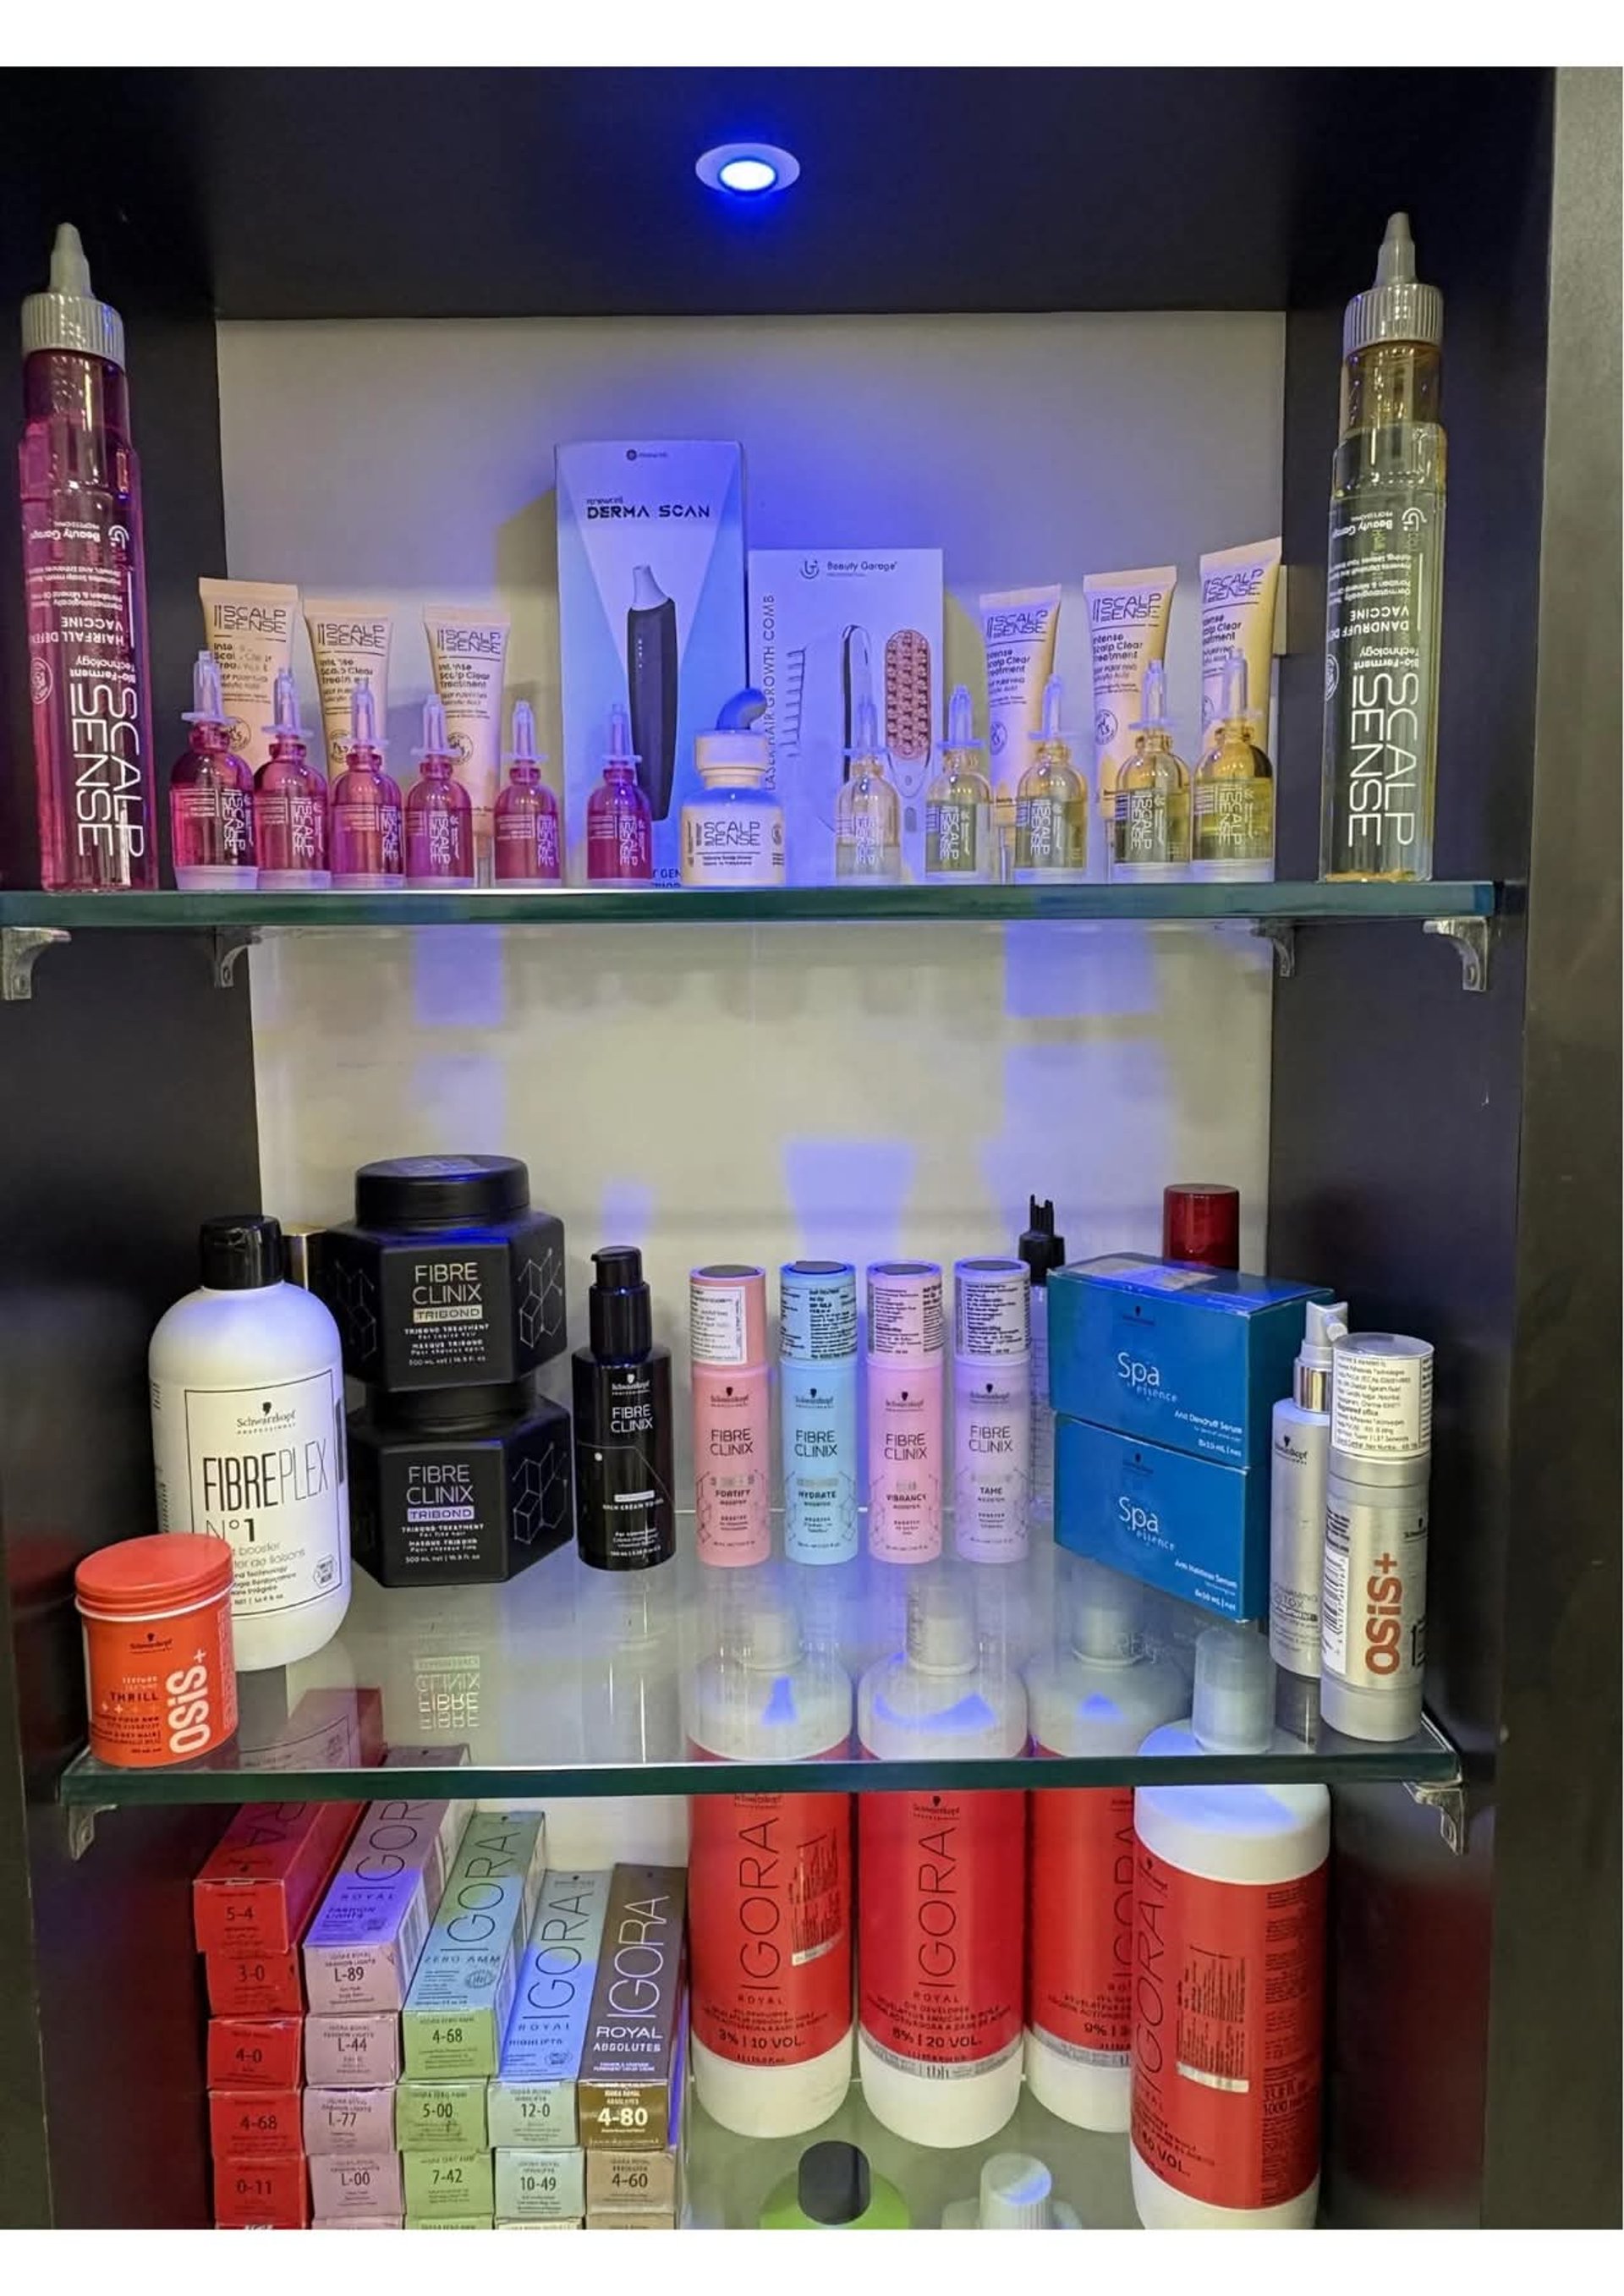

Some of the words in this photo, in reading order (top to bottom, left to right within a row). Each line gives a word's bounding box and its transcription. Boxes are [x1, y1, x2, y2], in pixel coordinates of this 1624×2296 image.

[588, 506, 650, 519] DERMA
[659, 505, 710, 518] SCAN
[1358, 519, 1393, 531] Beauty
[63, 527, 101, 542] Beauty
[827, 561, 858, 572] Beauty
[861, 561, 897, 572] Garage
[1102, 592, 1162, 609] SCALP
[223, 605, 286, 621] SCALP
[763, 595, 775, 641] COMB
[994, 609, 1049, 624] SCALP
[1100, 605, 1160, 622] SENSE
[1350, 605, 1409, 622] VACCINE
[61, 616, 123, 632] VACCINE
[223, 618, 287, 634] SENSE
[326, 623, 385, 637] SCALP
[1342, 621, 1409, 637] DANDRUFF
[63, 631, 124, 646] HAIRFALL
[445, 629, 501, 644] SCALP
[1359, 646, 1419, 658] Technology
[75, 655, 135, 673] Technology
[1353, 657, 1419, 670] Bio-Ferment
[764, 646, 775, 709] GROWTH
[1348, 673, 1385, 848] SENSE
[1385, 673, 1419, 845] SCALP
[69, 683, 113, 856] SENSE
[107, 685, 145, 857] SCALP
[233, 794, 246, 851] SCALP
[704, 821, 760, 836] SCALP
[1142, 798, 1153, 849] SCALP
[438, 816, 451, 865] SCALP
[704, 832, 760, 846] SENSE
[414, 1262, 479, 1283] FIBRE
[412, 1283, 483, 1305] CLINIX
[415, 1308, 480, 1321] TRIBOND
[1117, 1352, 1160, 1387] Spa
[1136, 1386, 1177, 1403] essence
[236, 1409, 296, 1428] Schwarzkopf
[612, 1404, 651, 1419] FIBRE
[611, 1416, 653, 1433] CLINIX
[970, 1425, 1011, 1439] FIBRE
[711, 1428, 751, 1442] FIBRE
[795, 1430, 835, 1443] FIBRE
[886, 1433, 926, 1447] FIBRE
[710, 1442, 754, 1457] CLINIX
[794, 1444, 837, 1458] CLINIX
[968, 1439, 1013, 1453] CLINIX
[884, 1447, 927, 1461] CLINIX
[202, 1438, 329, 1512] FIBREPLEX
[408, 1464, 470, 1484] FIBRE
[406, 1485, 475, 1505] CLINIX
[716, 1489, 751, 1498] FORTIFY
[798, 1490, 837, 1499] HYDRATE
[886, 1493, 927, 1502] VIBRANCY
[979, 1486, 1003, 1495] TAME
[409, 1508, 472, 1520] TRIBOND
[1118, 1496, 1159, 1533] Spa
[239, 1541, 281, 1556] booster
[1136, 1531, 1176, 1551] essence
[110, 1691, 159, 1701] THRILL
[440, 1832, 521, 1952] IGORA
[738, 1816, 780, 1991] IGORA
[918, 1826, 957, 1987] IGORA
[225, 1907, 254, 1921] 5-4
[467, 1955, 501, 1964] AMM
[522, 1892, 593, 2019] IGORA
[606, 1895, 670, 2019] IGORA
[238, 1964, 266, 1982] 3-0
[334, 1965, 365, 1982] L-89
[738, 1993, 783, 2005] ROYAL
[914, 1991, 960, 2003] ROYAL
[1136, 1901, 1165, 2094] IGORA
[432, 2028, 463, 2044] 4-68
[595, 2026, 663, 2039] ROYAL
[718, 2028, 739, 2046] 3%
[751, 2037, 768, 2049] 10
[771, 2035, 805, 2049] VOL.
[338, 2038, 367, 2052] L-44
[593, 2042, 661, 2052] ABSOLUTES
[925, 2035, 945, 2048] 20
[948, 2034, 983, 2048] VOL.
[235, 2046, 262, 2063] 4-0
[423, 2103, 453, 2118] 5-00
[520, 2103, 550, 2117] 12-0
[596, 2107, 648, 2127] 4-80
[239, 2115, 277, 2130] 4-68
[328, 2112, 357, 2126] L-77
[341, 2172, 370, 2187] L-00
[432, 2168, 463, 2183] 7-42
[612, 2173, 648, 2188] 4-60
[237, 2179, 272, 2194] 0-11
[520, 2176, 557, 2191] 10-49
